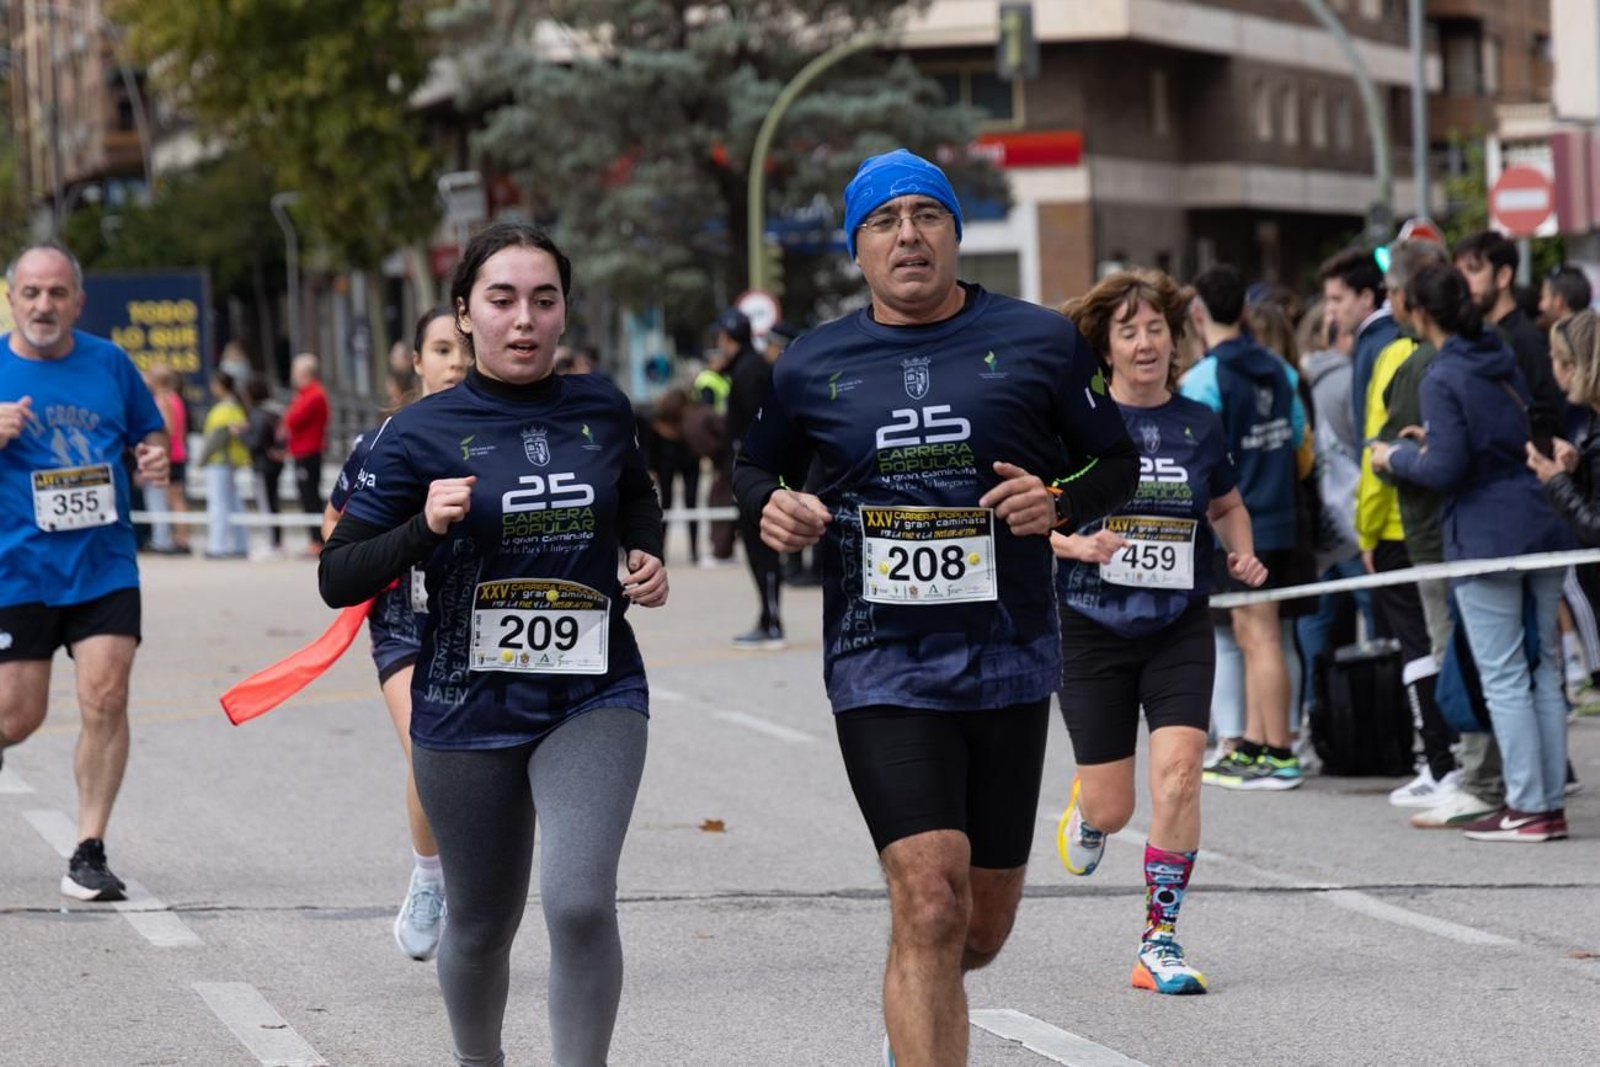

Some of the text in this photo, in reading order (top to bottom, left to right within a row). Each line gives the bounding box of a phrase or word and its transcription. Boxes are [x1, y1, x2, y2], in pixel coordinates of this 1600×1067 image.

[128, 300, 198, 324] TODO
[148, 325, 198, 349] QUE
[46, 404, 100, 431] CROSS
[876, 405, 972, 449] 25
[877, 442, 973, 462] CARRERA
[879, 455, 976, 475] POPULAR
[892, 472, 920, 482] gran
[922, 466, 978, 479] caminata
[53, 490, 100, 516] 355
[502, 472, 595, 514] 25
[1135, 489, 1193, 499] OPULAR
[502, 506, 594, 526] CARRERA
[866, 510, 987, 528] XXV CARRERA POPULAR
[894, 516, 987, 530] y gran caminata
[1107, 519, 1129, 532] XXV
[502, 518, 596, 539] POPULAR
[512, 535, 540, 546] gran
[541, 531, 595, 544] caminata
[888, 544, 966, 583] 208
[1121, 544, 1177, 572] 459
[479, 584, 510, 600] XXV
[511, 582, 557, 592] CARRERA
[554, 589, 604, 602] aminata
[498, 614, 579, 652] 209
[449, 660, 467, 683] DE
